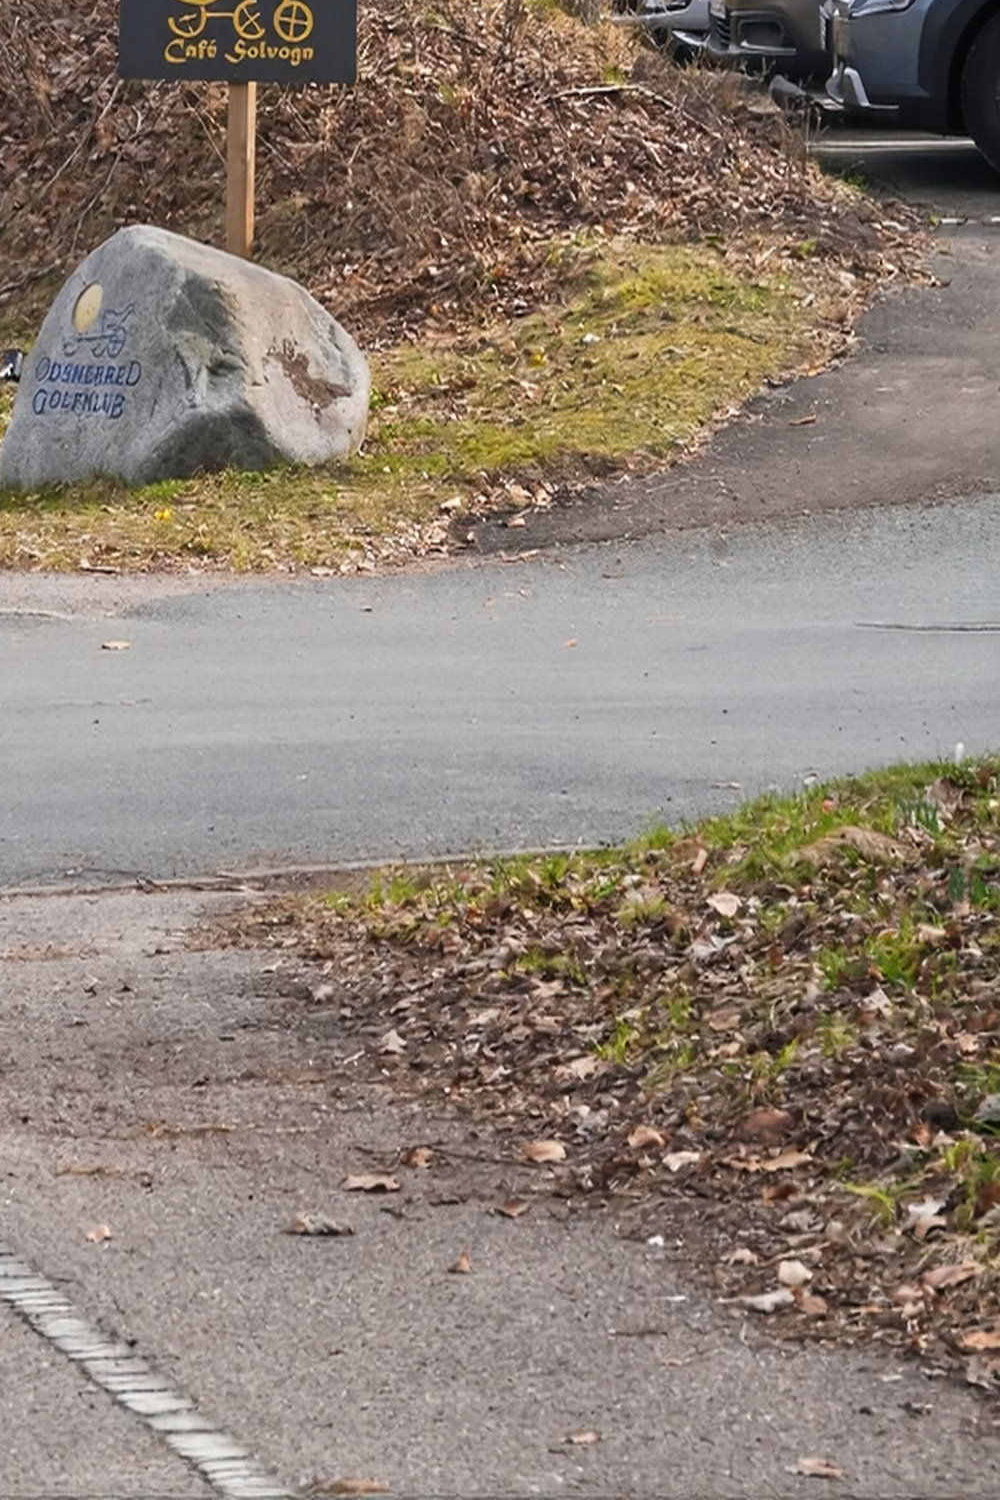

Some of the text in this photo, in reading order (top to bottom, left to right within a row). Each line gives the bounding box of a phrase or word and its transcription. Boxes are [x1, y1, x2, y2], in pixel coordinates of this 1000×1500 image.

[164, 39, 314, 66] Café Solvogn
[35, 357, 142, 386] ODSHERRED
[33, 389, 125, 419] GOLFKLUB
